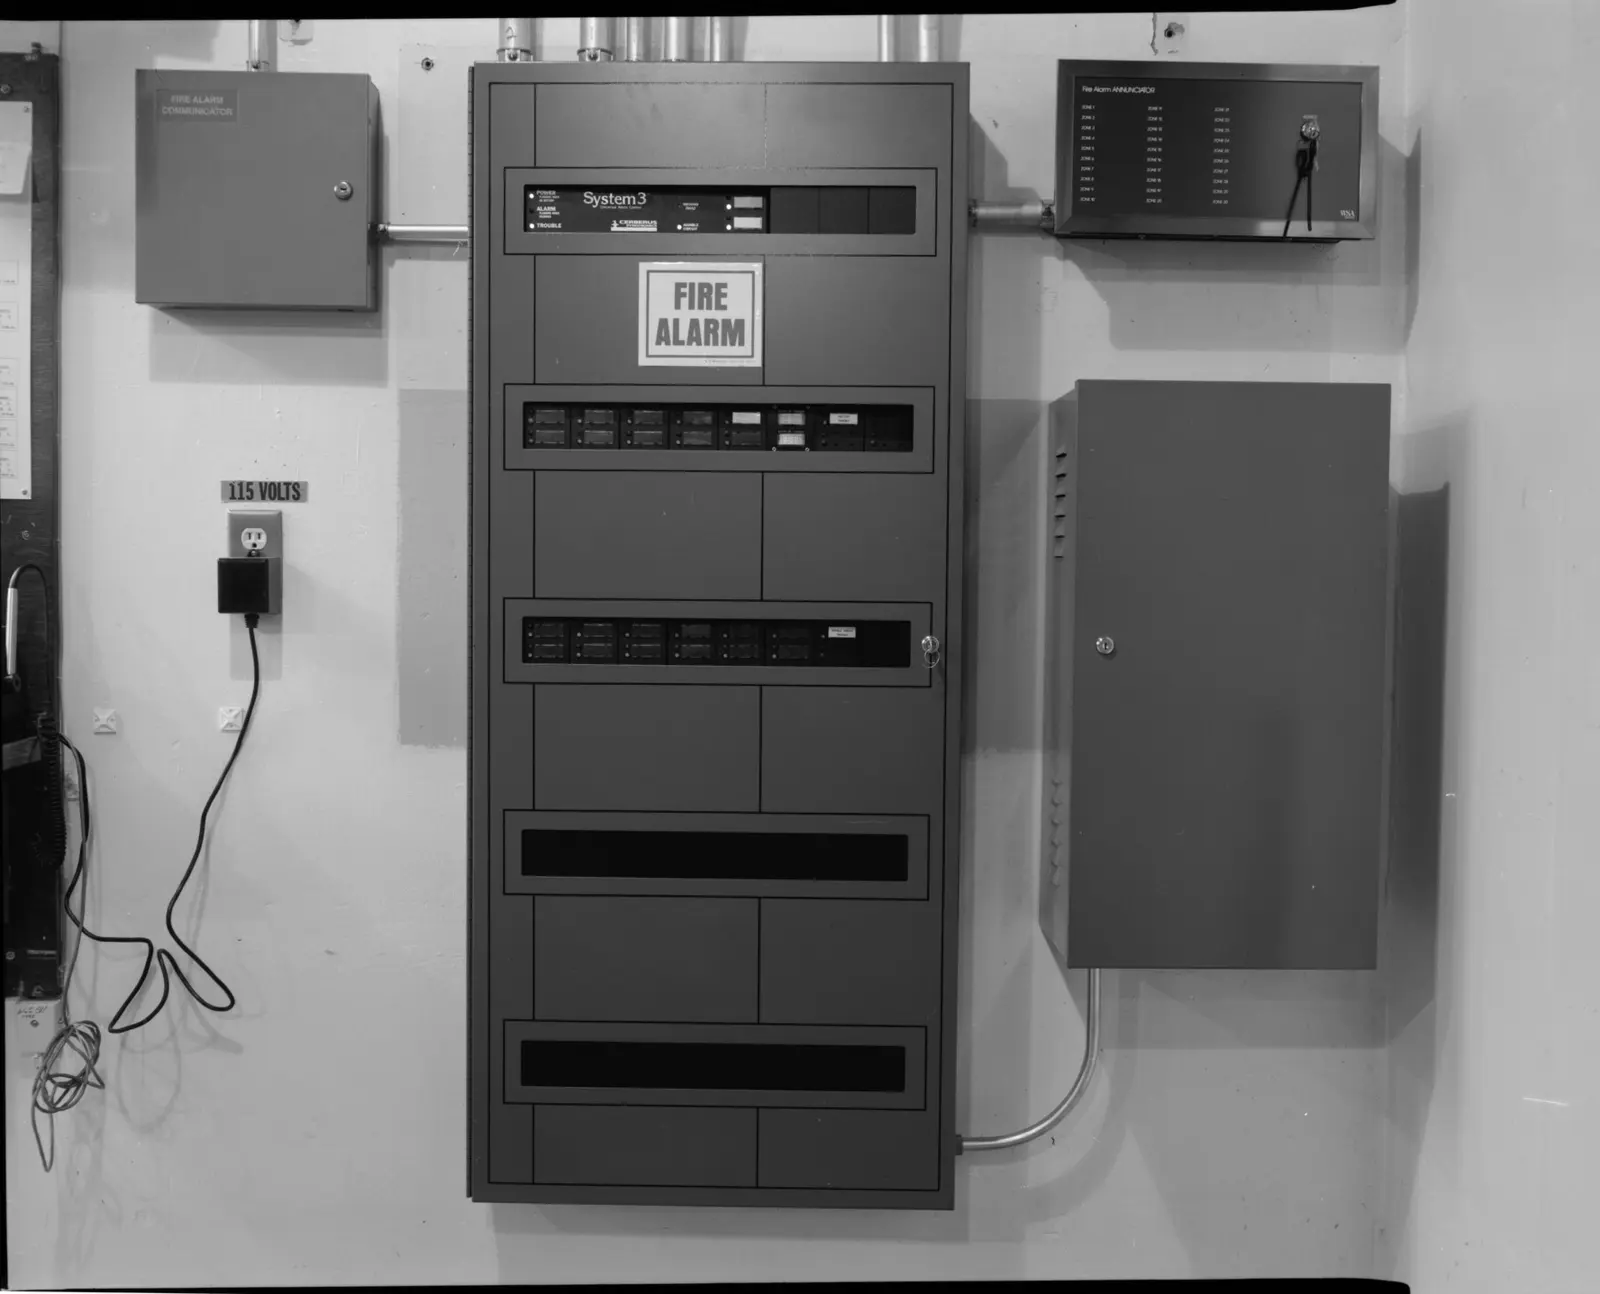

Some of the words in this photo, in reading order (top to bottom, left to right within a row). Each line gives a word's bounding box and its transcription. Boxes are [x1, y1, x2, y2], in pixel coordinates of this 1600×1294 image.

[1082, 85, 1093, 93] Fire
[1093, 85, 1112, 93] Alarm
[1112, 86, 1156, 94] ANNUNCIATOR
[192, 95, 224, 105] ALARM
[161, 106, 234, 116] COMMUNICATOR
[674, 282, 728, 310] FIRE
[655, 318, 745, 346] ALARM
[229, 481, 254, 500] 115
[259, 481, 301, 501] VOLTS
